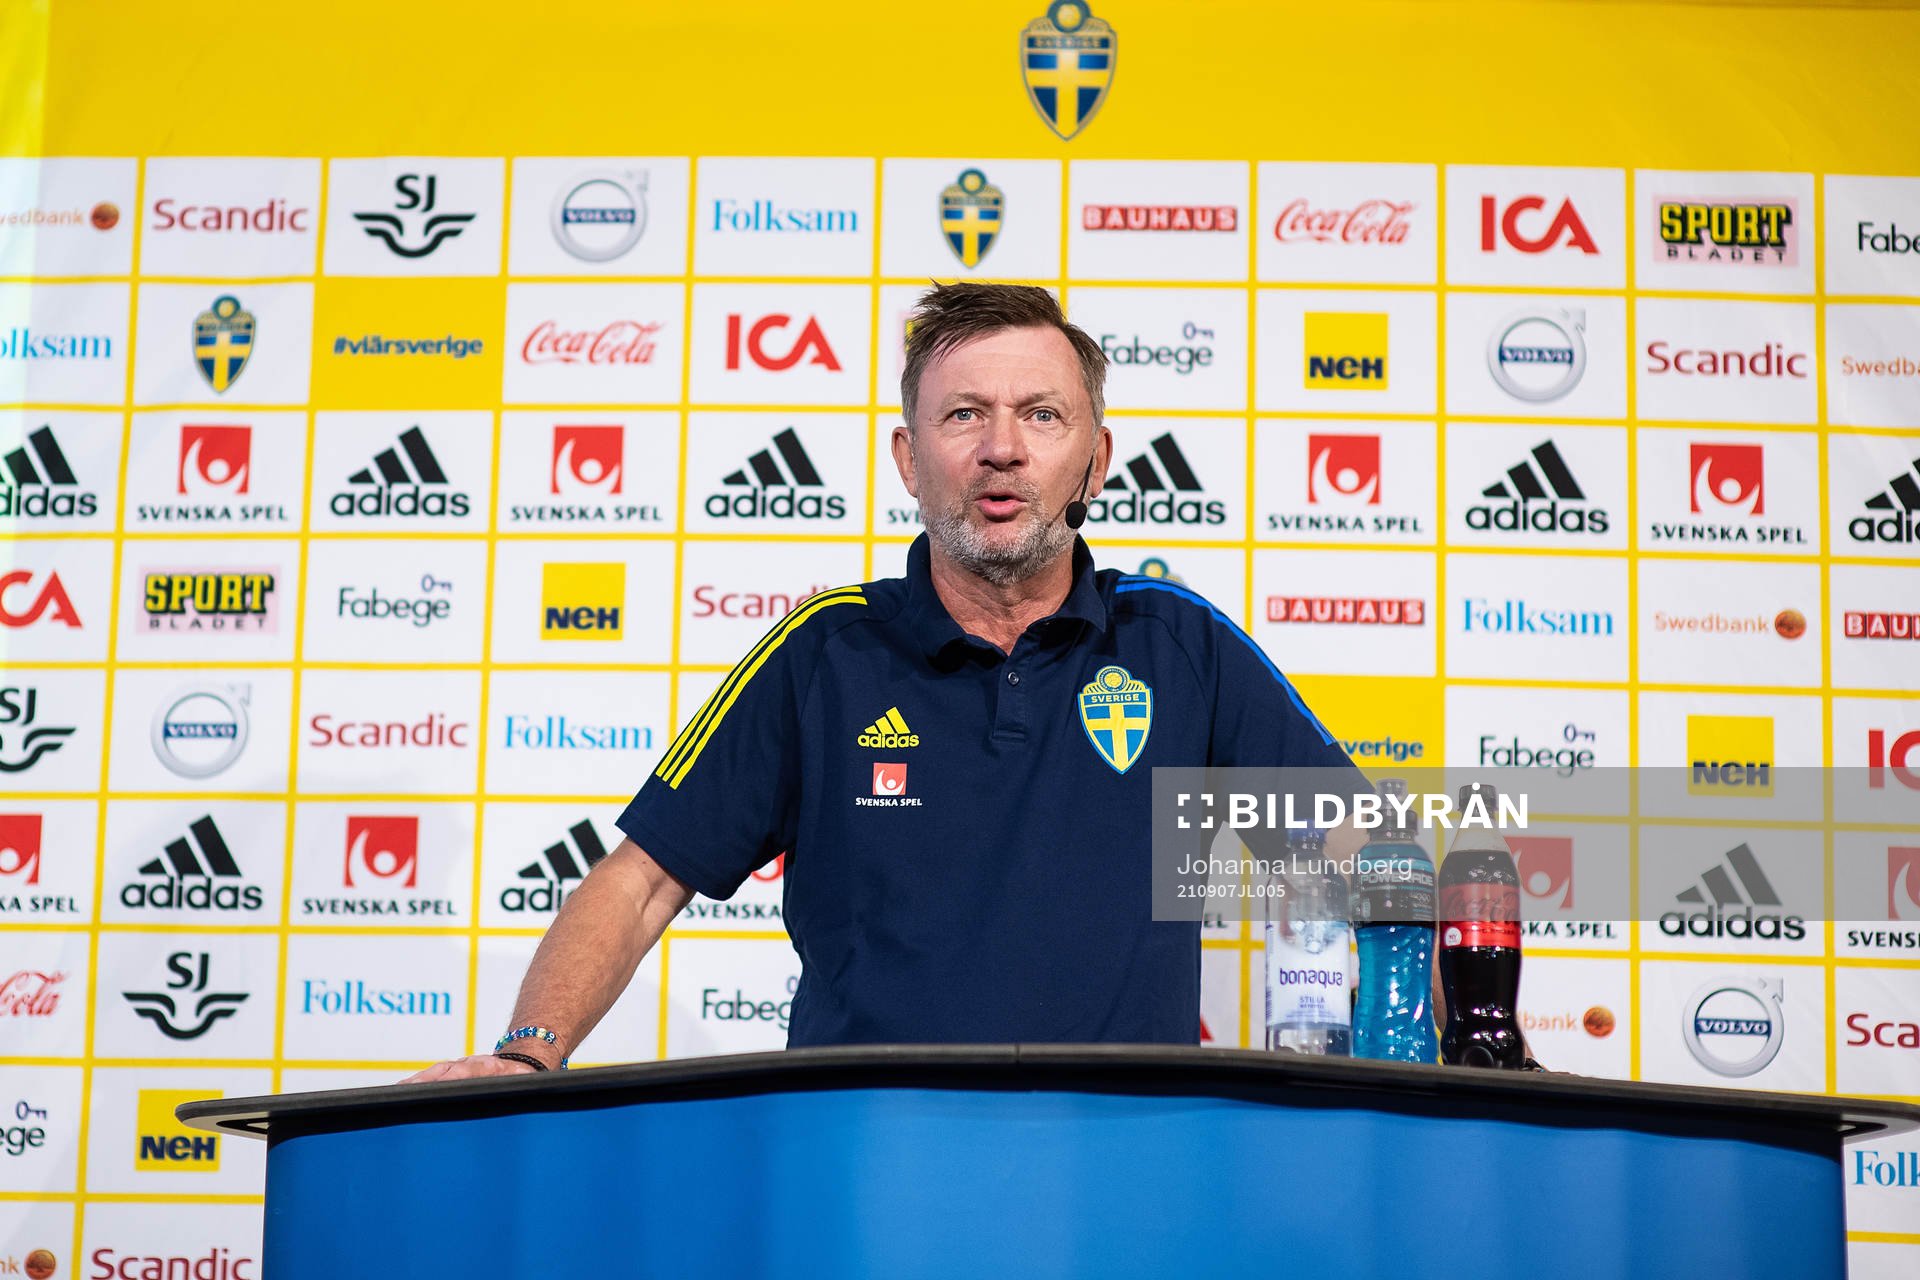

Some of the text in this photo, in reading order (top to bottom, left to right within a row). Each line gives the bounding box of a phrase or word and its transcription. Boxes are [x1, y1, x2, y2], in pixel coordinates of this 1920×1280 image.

[393, 173, 437, 213] SJ
[153, 199, 307, 233] Scandic
[564, 208, 634, 222] VOLVO
[712, 199, 858, 234] Folksam
[1085, 206, 1236, 230] BAUHAUS
[1273, 200, 1413, 245] Coca-Cola
[1480, 195, 1600, 255] ICA
[1660, 202, 1792, 246] SPORT
[1666, 248, 1786, 263] BLADET
[521, 321, 660, 365] Coca-Cola
[725, 313, 843, 372] ICA
[1100, 335, 1213, 374] Fabege
[1502, 348, 1573, 363] VOLVO
[1647, 342, 1806, 378] Scandic
[1841, 354, 1920, 377] Swedb
[138, 505, 287, 521] SVENSKA SPEL
[330, 484, 470, 517] adidas
[511, 506, 662, 521] SVENSKA SPEL
[704, 487, 846, 519] adidas
[1088, 493, 1226, 524] adidas
[1465, 497, 1609, 534] adidas
[1268, 515, 1421, 532] SVENSKA SPEL
[1651, 525, 1806, 543] SVENSKA SPEL
[1849, 510, 1920, 542] adi
[145, 573, 274, 615] SPORT
[337, 586, 452, 628] Fabege
[148, 616, 266, 630] BLADET
[1267, 599, 1424, 623] BAUHAUS
[1464, 598, 1613, 638] Folksam
[1654, 612, 1769, 633] Swedbank
[0, 687, 37, 726] SJ
[1091, 693, 1140, 703] SVERIGE
[166, 722, 238, 739] VOLVO
[310, 713, 467, 748] Scandic
[504, 715, 653, 752] Folksam
[857, 733, 920, 748] adidas
[1480, 735, 1596, 777] Fabege
[855, 797, 923, 807] SVENSKA SPEL
[30, 897, 78, 912] SPEL
[120, 876, 263, 910] adidas
[304, 899, 456, 915] SVENSKA SPEL
[501, 880, 577, 912] adi
[684, 903, 782, 919] SVENSKA
[1659, 904, 1808, 940] adidas
[1565, 922, 1618, 939] SPEL
[1848, 931, 1920, 948] SVENS
[166, 952, 210, 992] SJ
[1278, 966, 1344, 990] bonaqua
[303, 979, 452, 1016] Folksam
[1516, 1011, 1577, 1031] bank
[1698, 1020, 1769, 1034] VOLVO
[91, 1248, 252, 1280] Scandic
